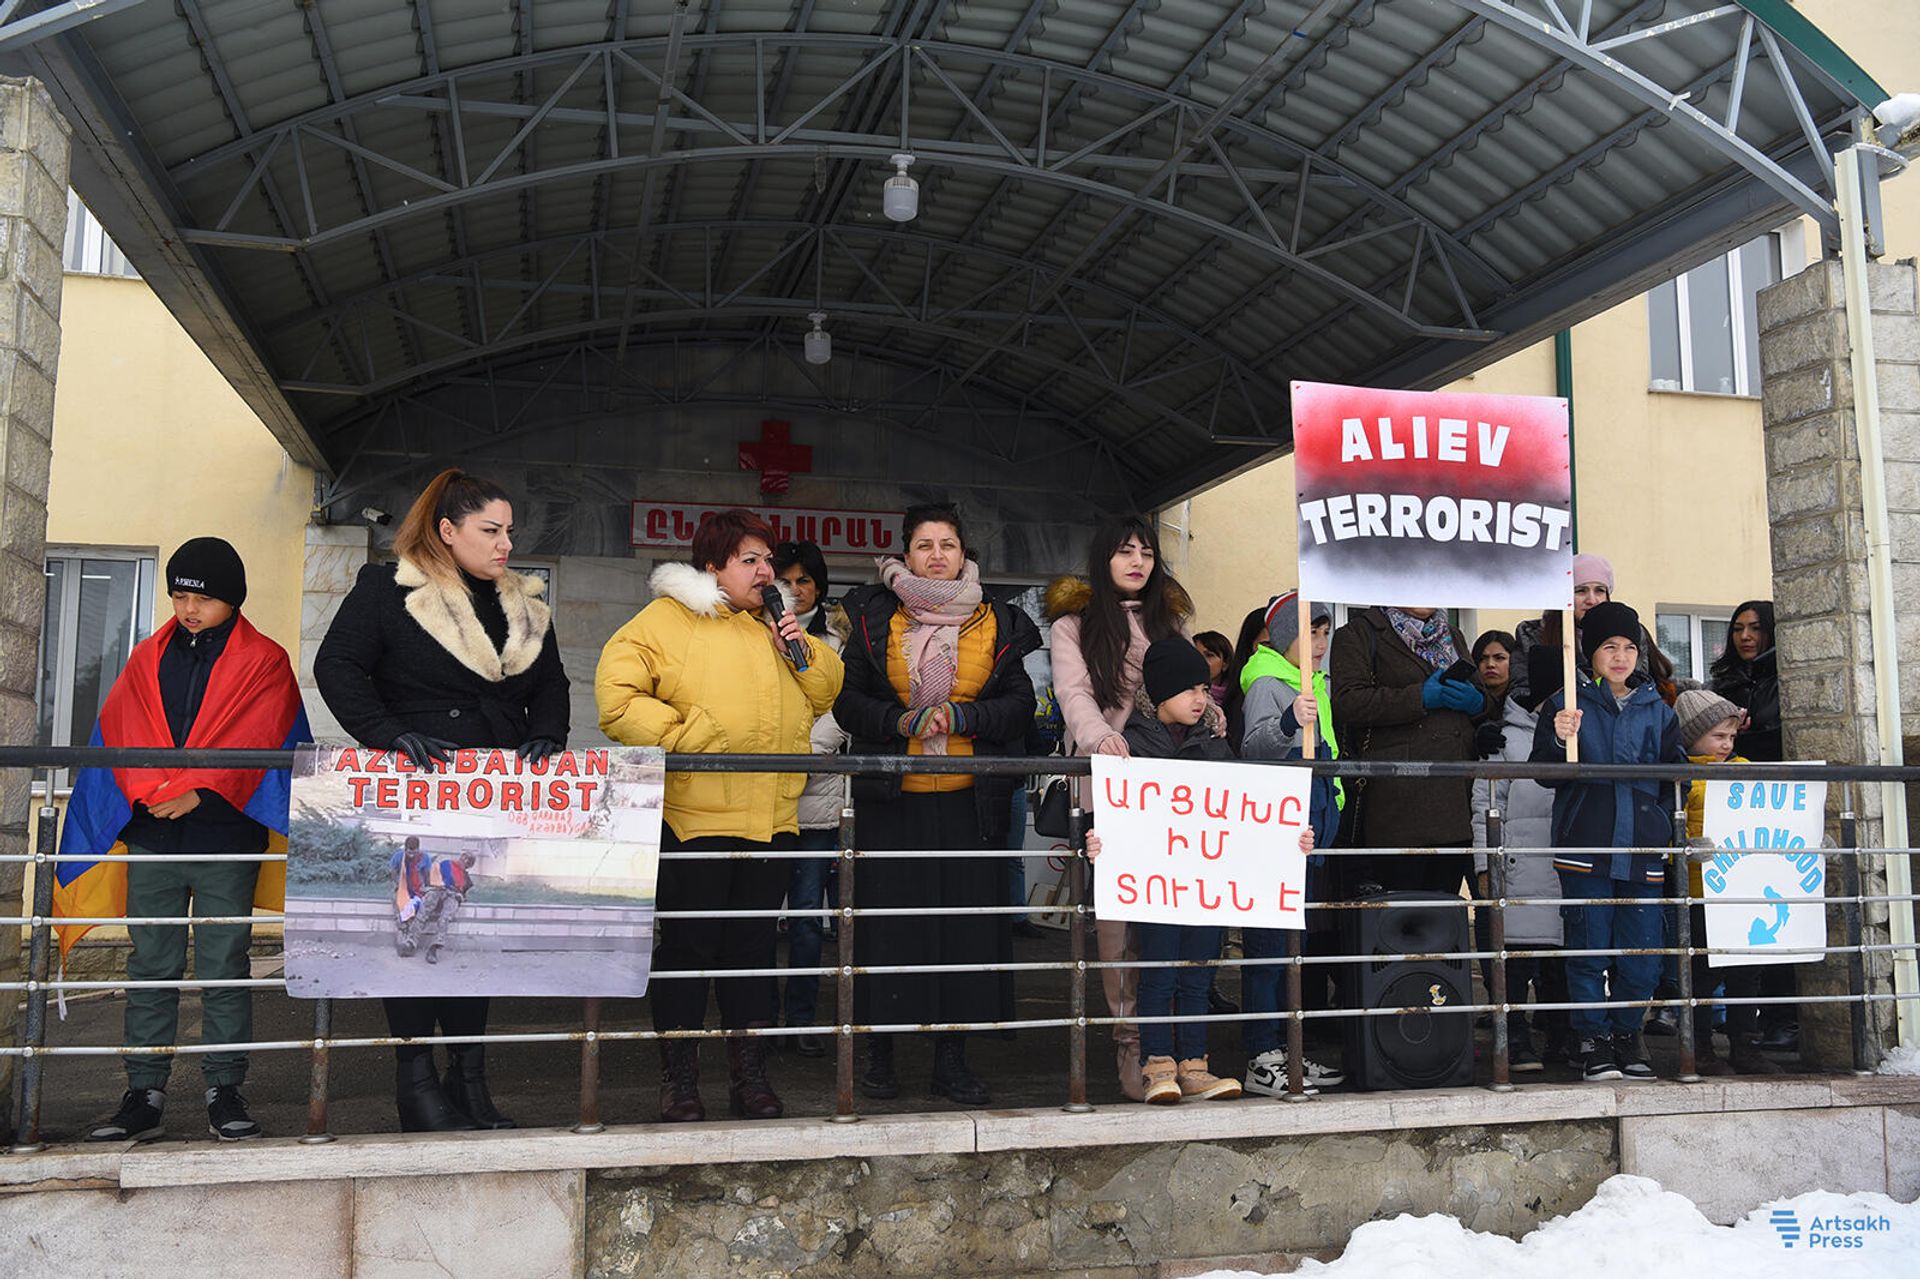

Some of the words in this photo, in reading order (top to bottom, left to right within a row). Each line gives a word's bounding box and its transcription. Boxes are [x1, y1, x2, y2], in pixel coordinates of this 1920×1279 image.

[1341, 416, 1511, 467] ALIEV
[646, 508, 893, 548] ԸՆՆԱՐԱՆ
[1299, 493, 1570, 551] TERRORIST
[347, 777, 598, 812] TERRORIST
[1106, 778, 1302, 826] ԱՐՑԱԽԸ
[1727, 782, 1807, 811] SAVE
[1168, 827, 1230, 860] ԻՄ
[1704, 827, 1823, 894] CHILDHOOD
[1117, 873, 1254, 911] ՏՈՒՆՆ
[1279, 882, 1300, 912] Է
